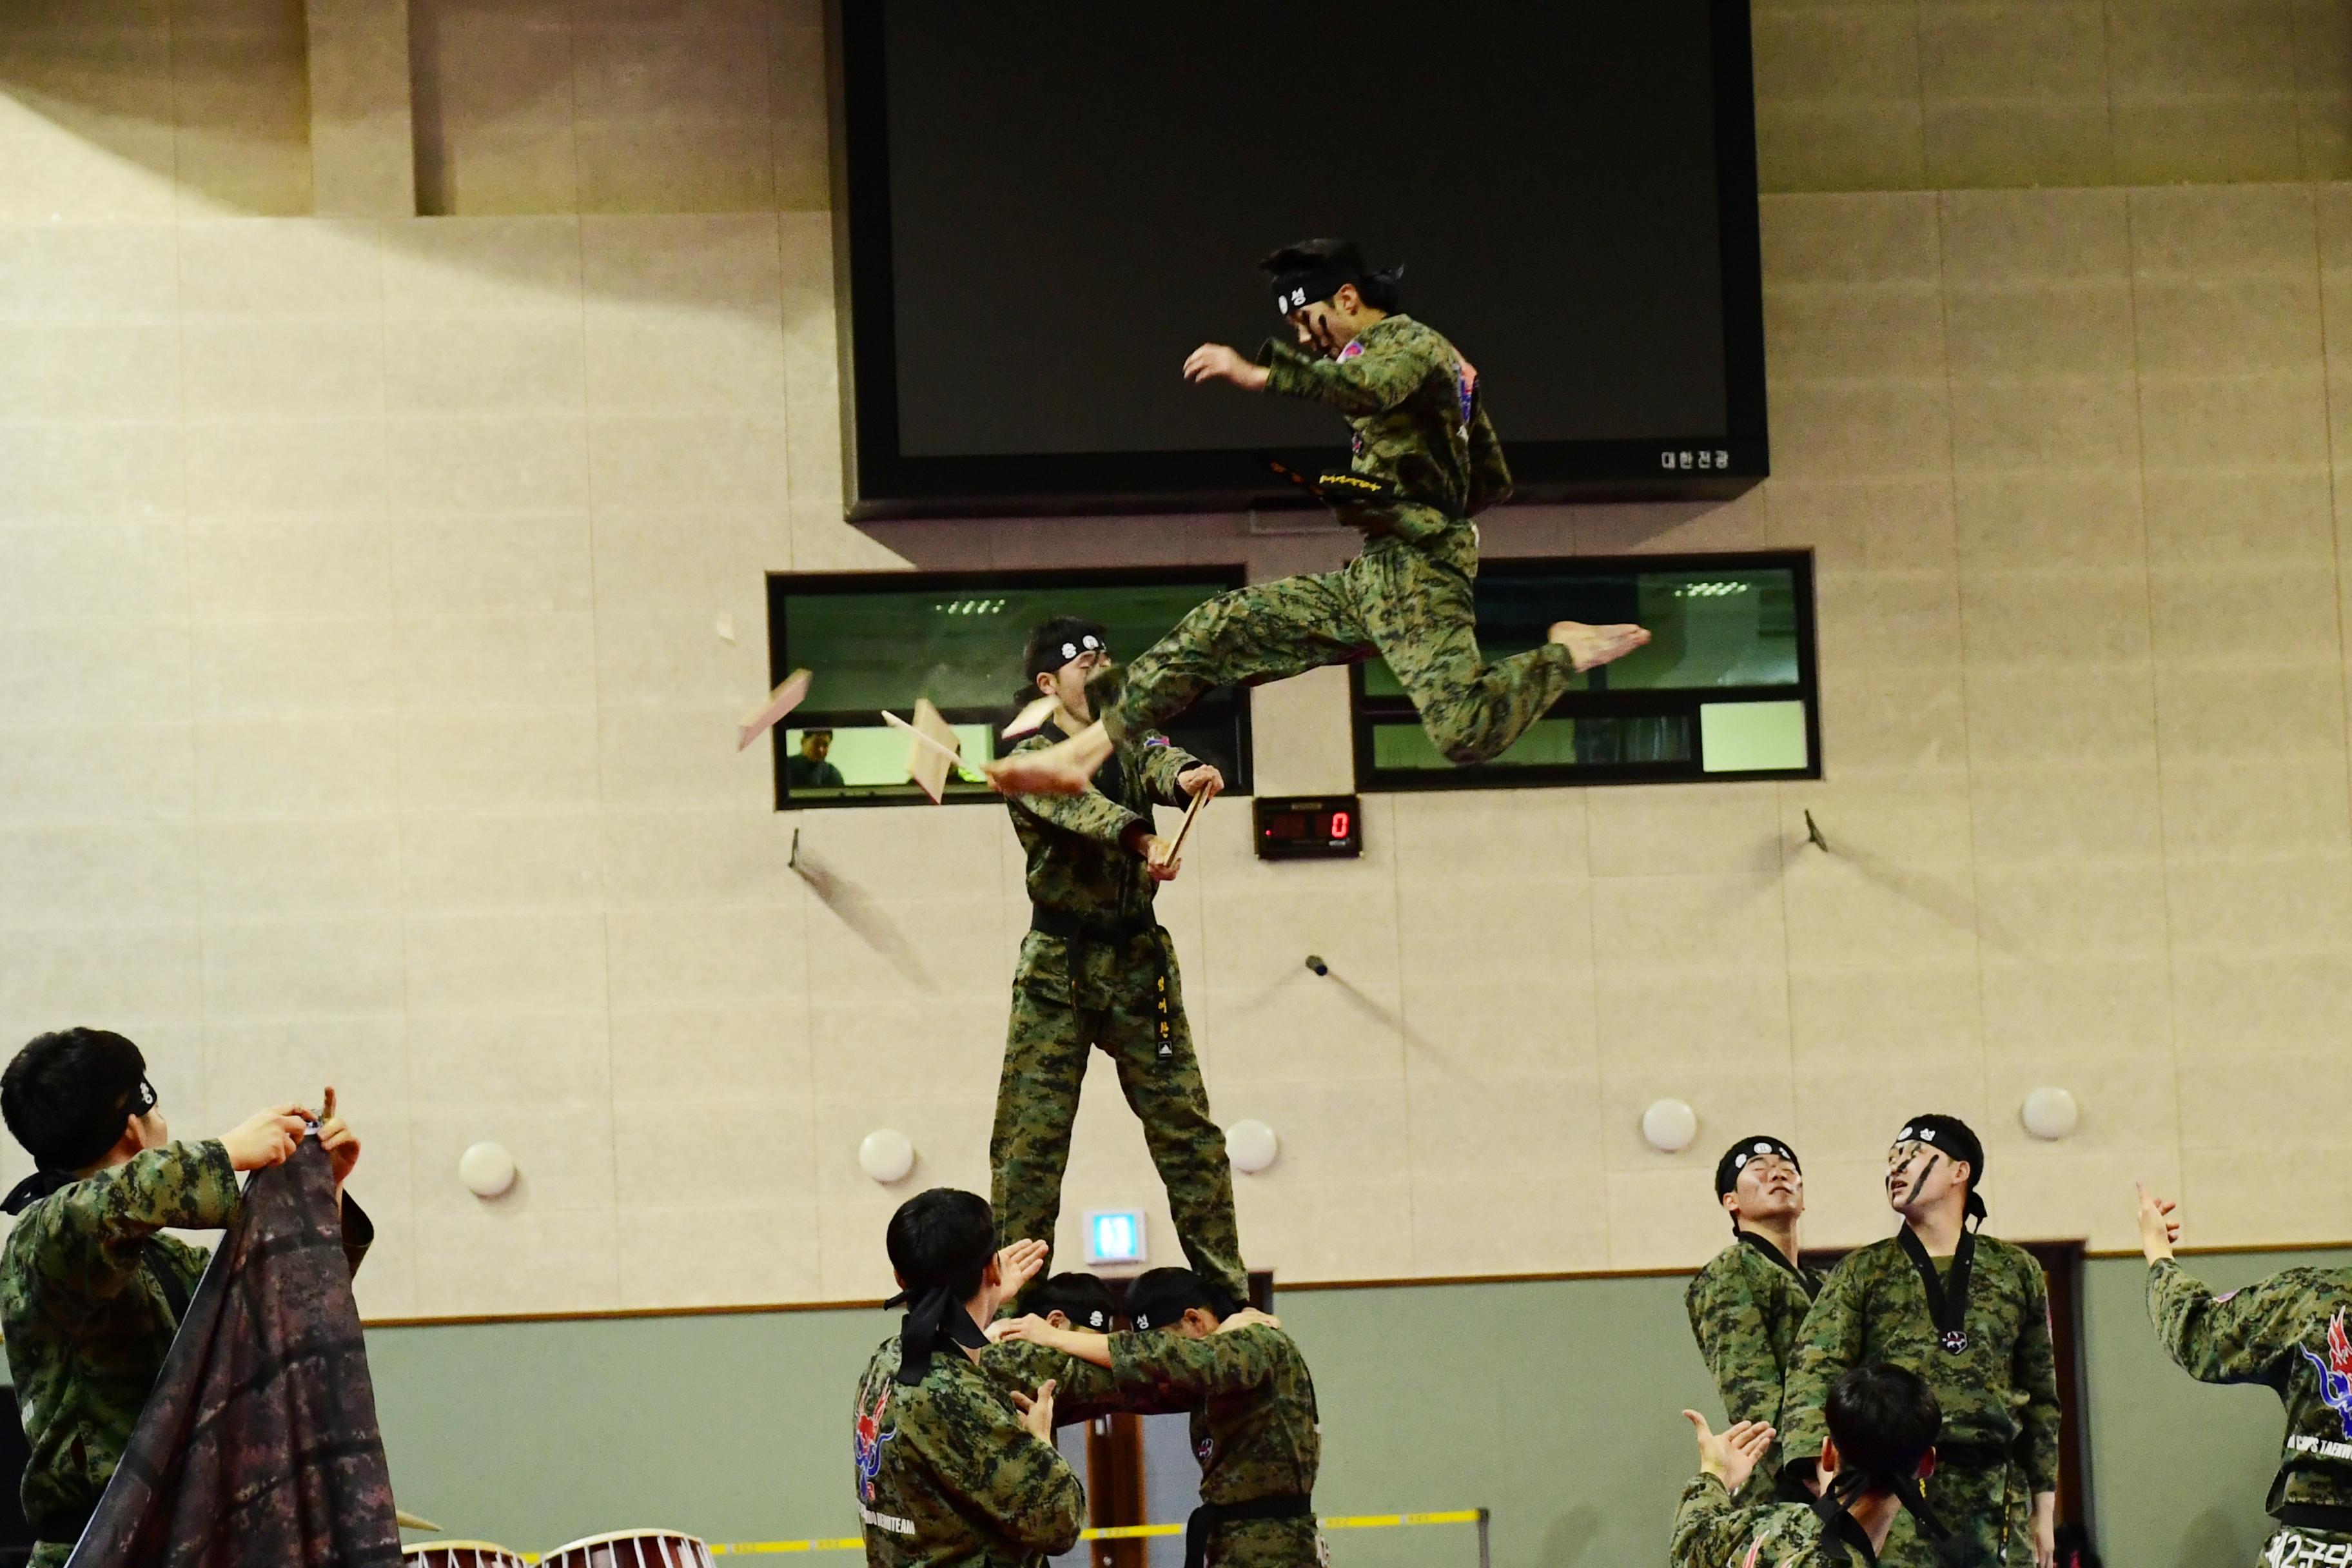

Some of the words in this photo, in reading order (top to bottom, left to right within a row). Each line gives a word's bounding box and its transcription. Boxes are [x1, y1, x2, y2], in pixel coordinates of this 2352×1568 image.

[1291, 287, 1306, 306] 성
[1331, 812, 1349, 838] 0
[2319, 1440, 2352, 1461] TAEKW
